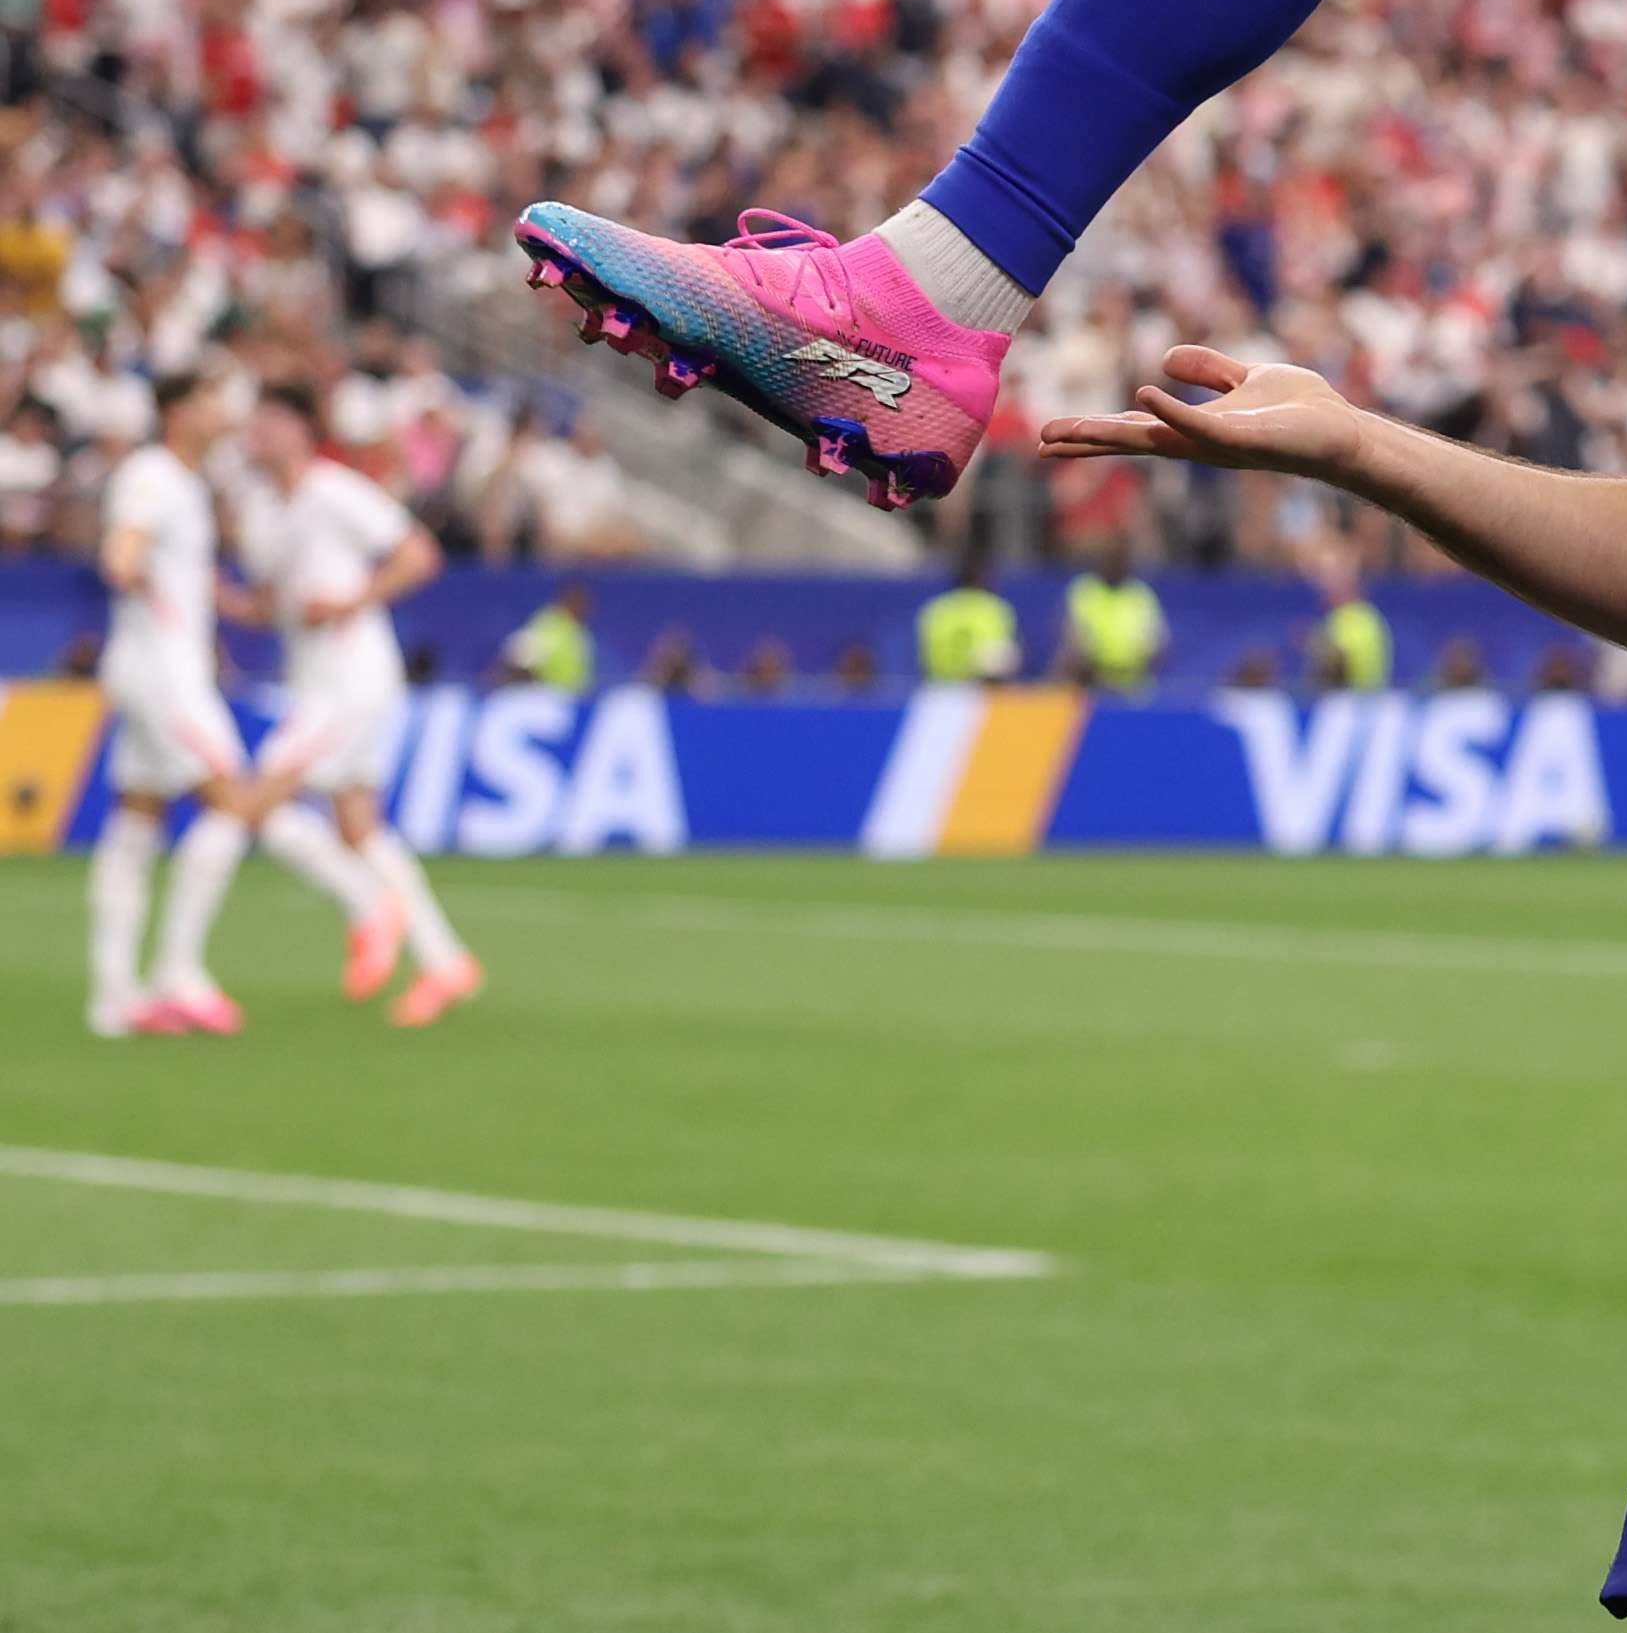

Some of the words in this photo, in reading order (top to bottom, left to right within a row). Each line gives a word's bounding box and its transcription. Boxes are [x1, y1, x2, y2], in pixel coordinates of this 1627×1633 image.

[855, 338, 918, 372] FUTURE
[385, 682, 692, 856] ISA
[1212, 686, 1613, 856] VISA
